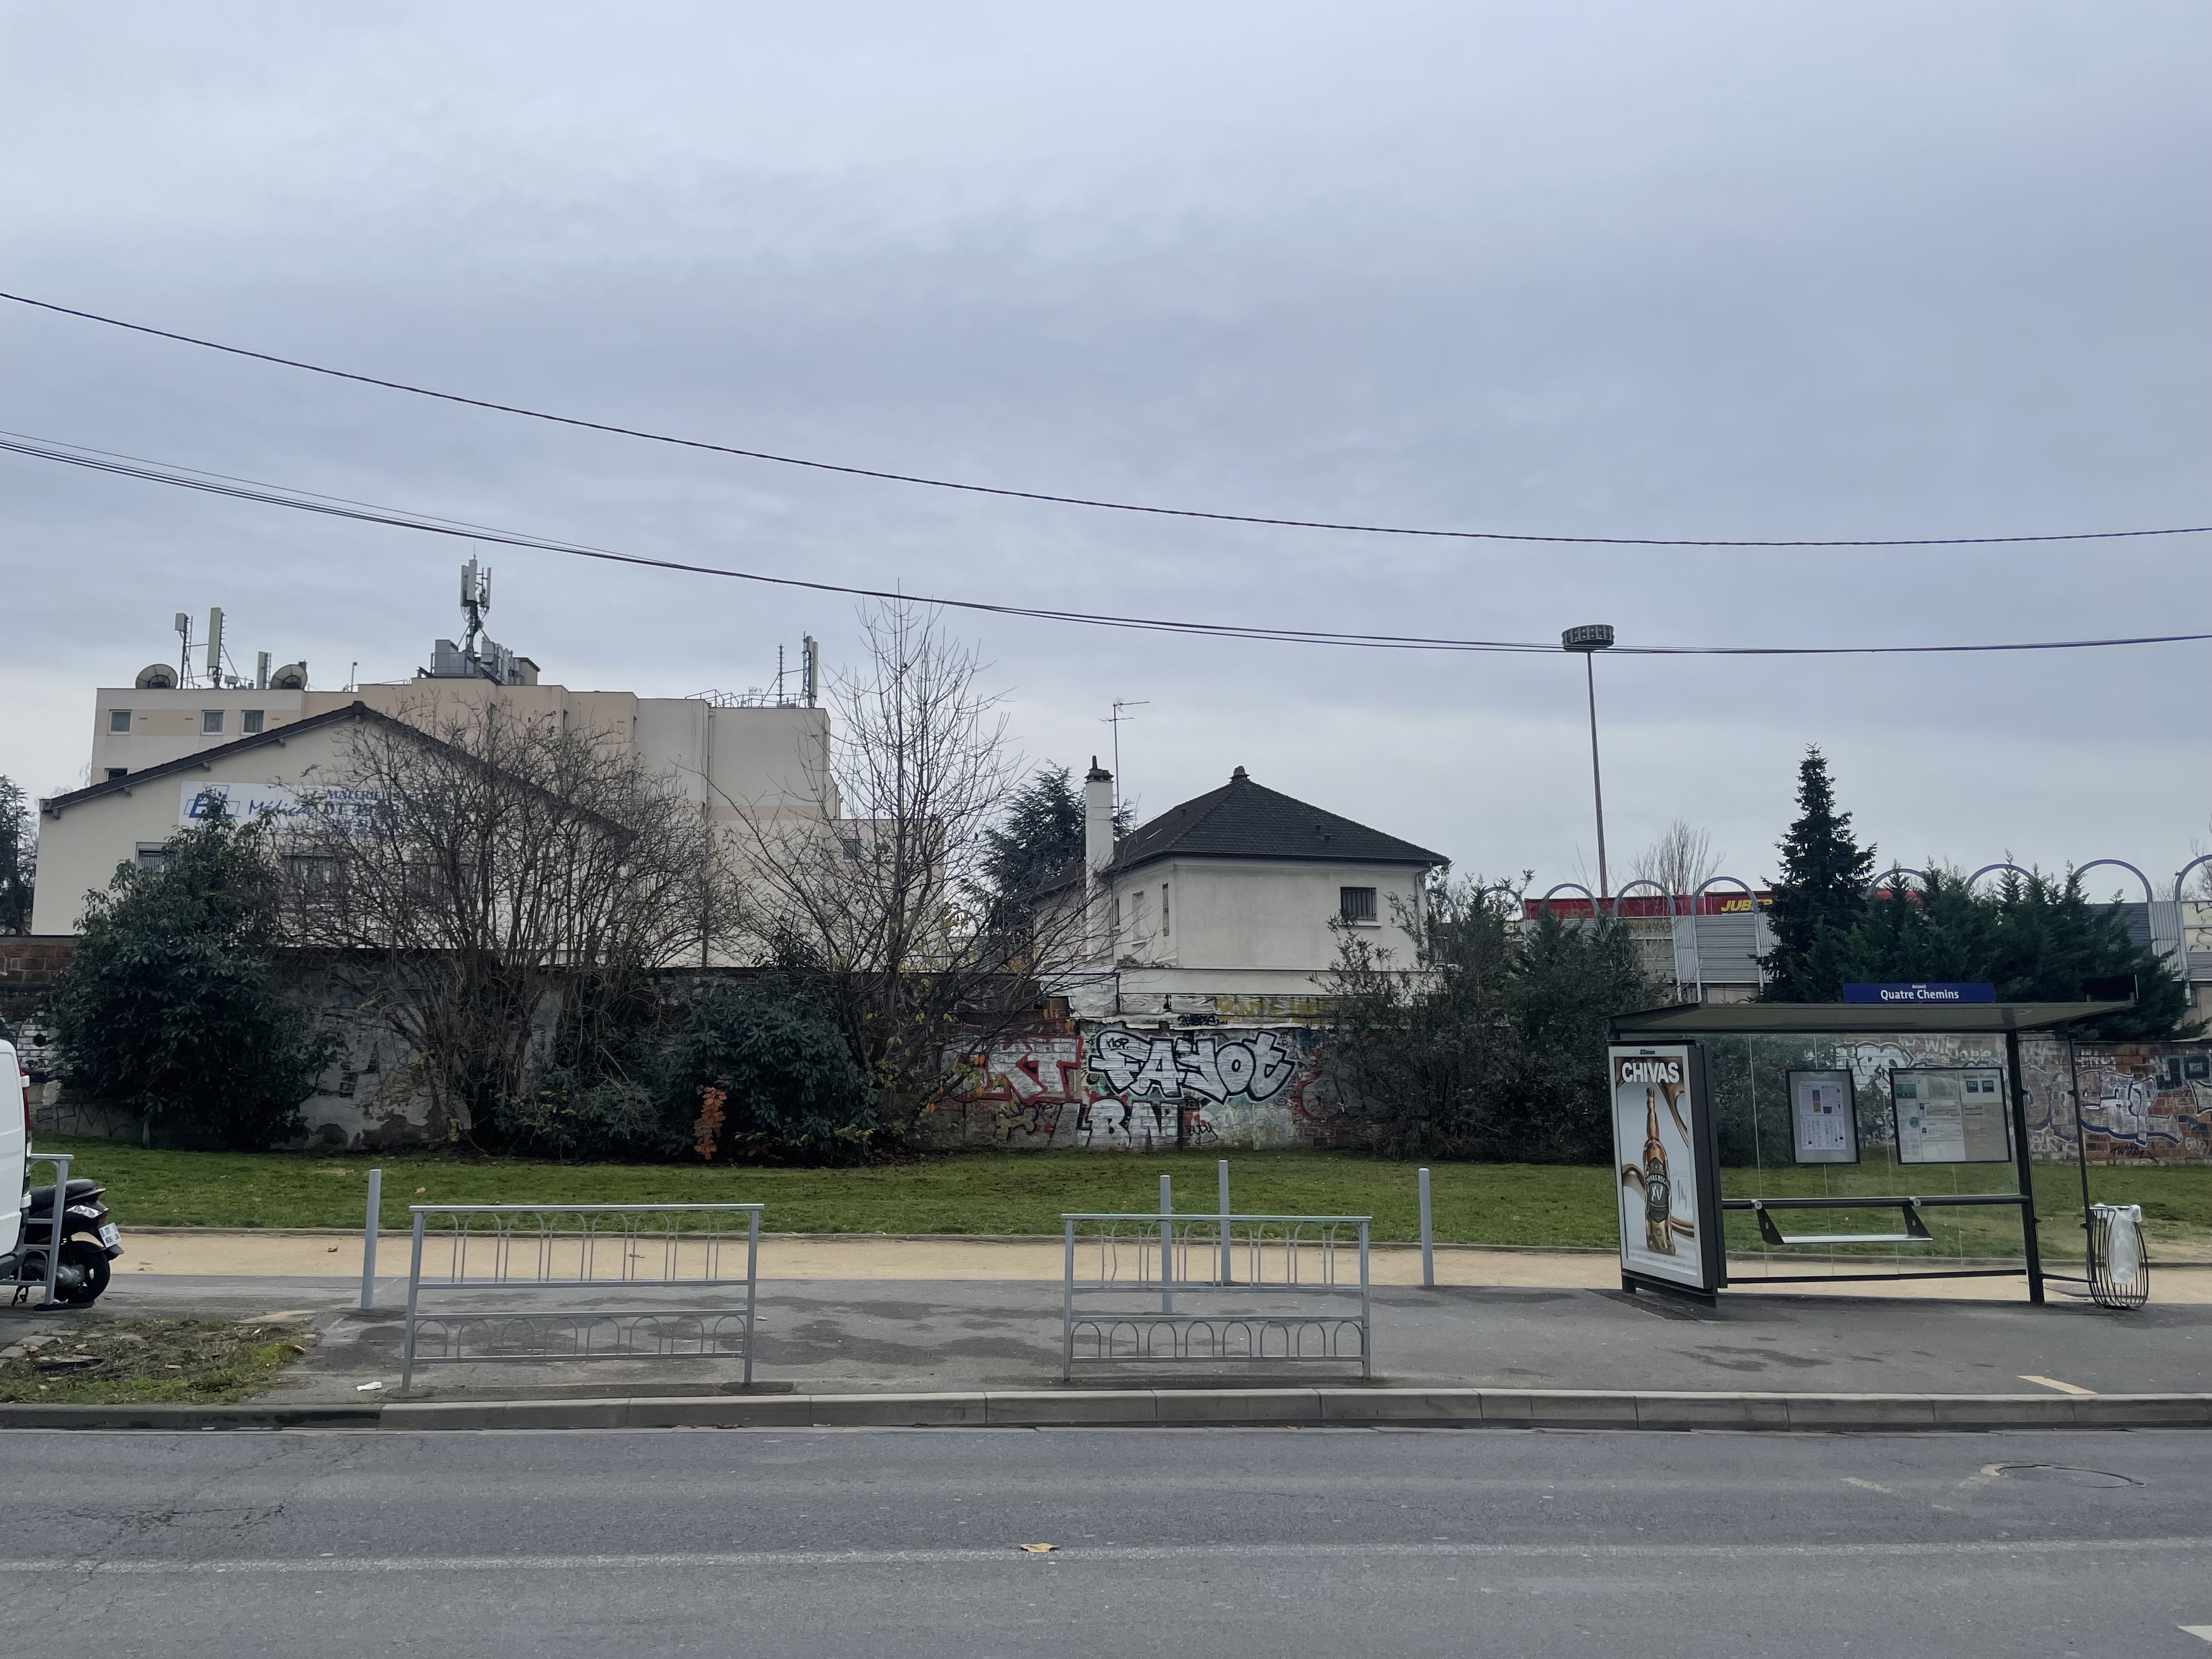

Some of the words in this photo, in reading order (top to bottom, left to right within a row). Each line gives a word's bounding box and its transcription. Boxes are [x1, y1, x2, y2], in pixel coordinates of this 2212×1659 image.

[1880, 989, 1914, 1001] Quatre
[1917, 989, 1959, 1000] Chemins
[1622, 1062, 1680, 1084] CHIVAS
